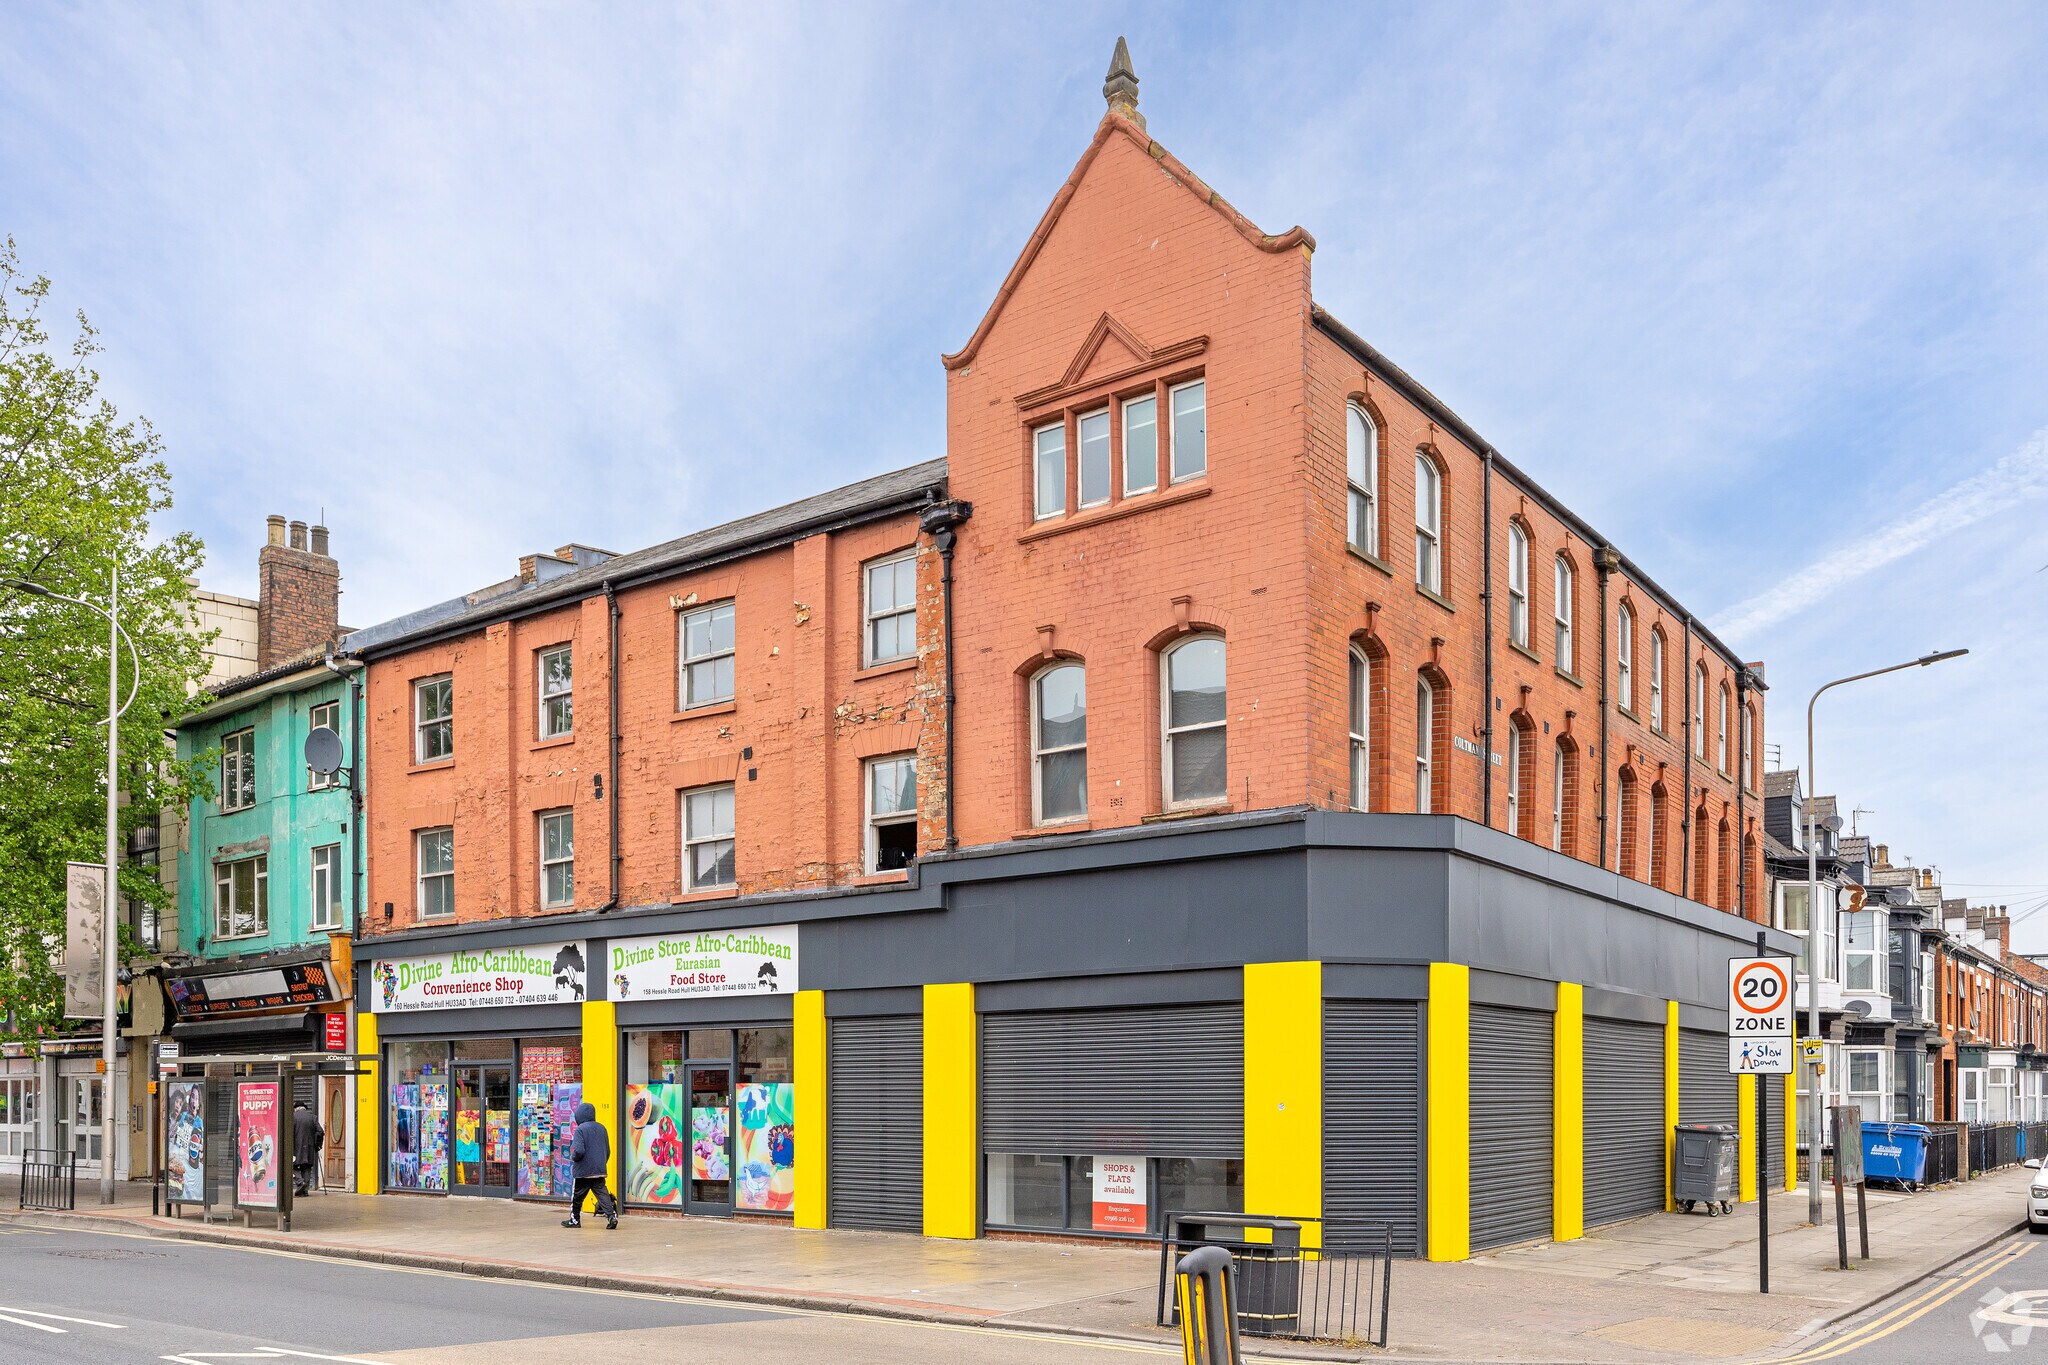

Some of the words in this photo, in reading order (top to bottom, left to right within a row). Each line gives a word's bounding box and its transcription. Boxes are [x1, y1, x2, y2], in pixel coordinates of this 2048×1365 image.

[612, 946, 655, 971] Divine
[658, 939, 691, 959] Store
[694, 933, 792, 961] Afro-Caribbean
[399, 962, 443, 991] Divine
[450, 949, 553, 977] Afro-Caribbean
[675, 955, 721, 971] Eurasian
[423, 979, 492, 996] Convenience
[495, 976, 524, 994] Shop
[670, 973, 695, 986] Food
[698, 972, 726, 984] Store
[651, 987, 668, 995] Hessle
[680, 986, 690, 994] Hull
[690, 985, 711, 993] HU33AD
[1742, 977, 1778, 998] 20
[293, 993, 315, 1003] CHICKEN
[393, 1002, 402, 1010] 160
[403, 1001, 420, 1010] Hessle
[420, 1000, 434, 1009] Road
[434, 999, 445, 1008] Hull
[445, 998, 468, 1007] HU33AD
[469, 998, 479, 1006] Tel:
[479, 997, 494, 1006] 07448
[504, 996, 514, 1004] 732
[518, 995, 535, 1004] 07404
[536, 994, 547, 1003] 639
[547, 993, 559, 1002] 446
[1735, 1017, 1786, 1031] ZONE
[1756, 1044, 1782, 1058] Slow
[1753, 1058, 1780, 1067] Down
[242, 1100, 274, 1111] PUPPY
[1103, 1163, 1129, 1173] SHOPS
[1129, 1165, 1136, 1173] &
[1107, 1174, 1131, 1184] FLATS
[1103, 1185, 1135, 1195] available
